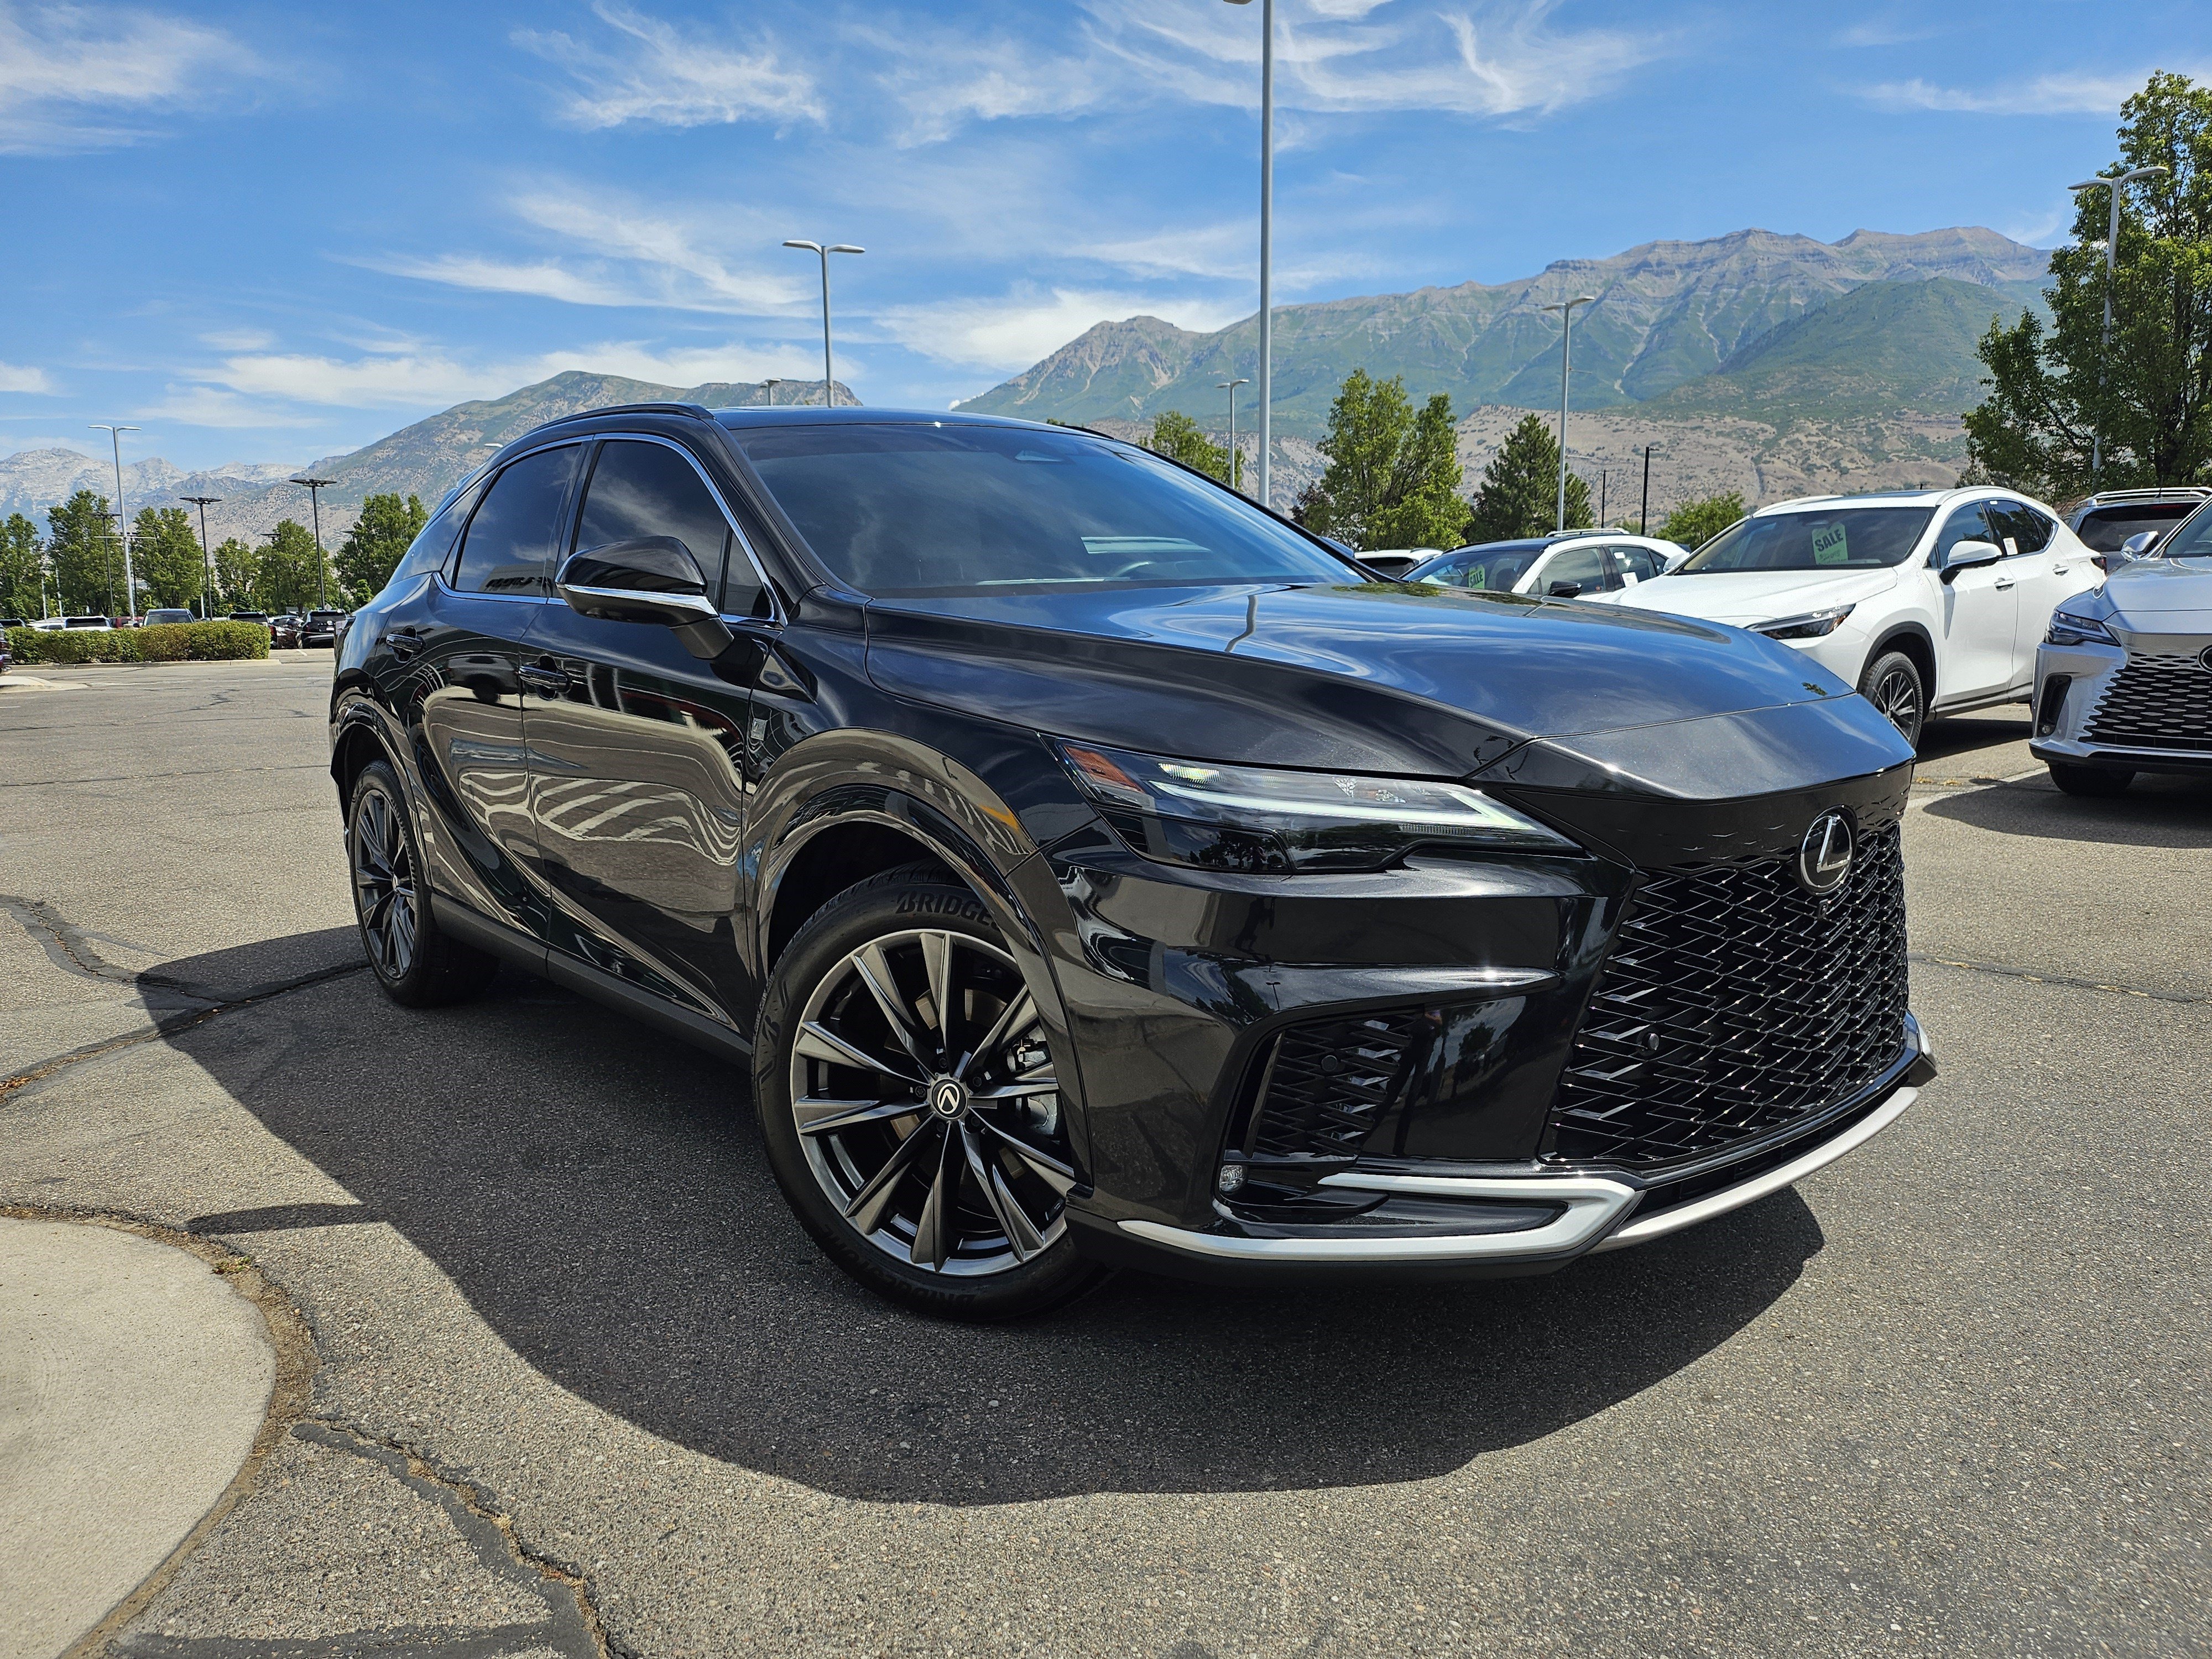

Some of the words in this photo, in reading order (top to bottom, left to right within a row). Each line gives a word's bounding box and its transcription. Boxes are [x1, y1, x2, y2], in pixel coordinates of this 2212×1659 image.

[1815, 529, 1844, 551] SALE
[1470, 570, 1483, 588] SALE
[894, 889, 993, 927] BRIDGE
